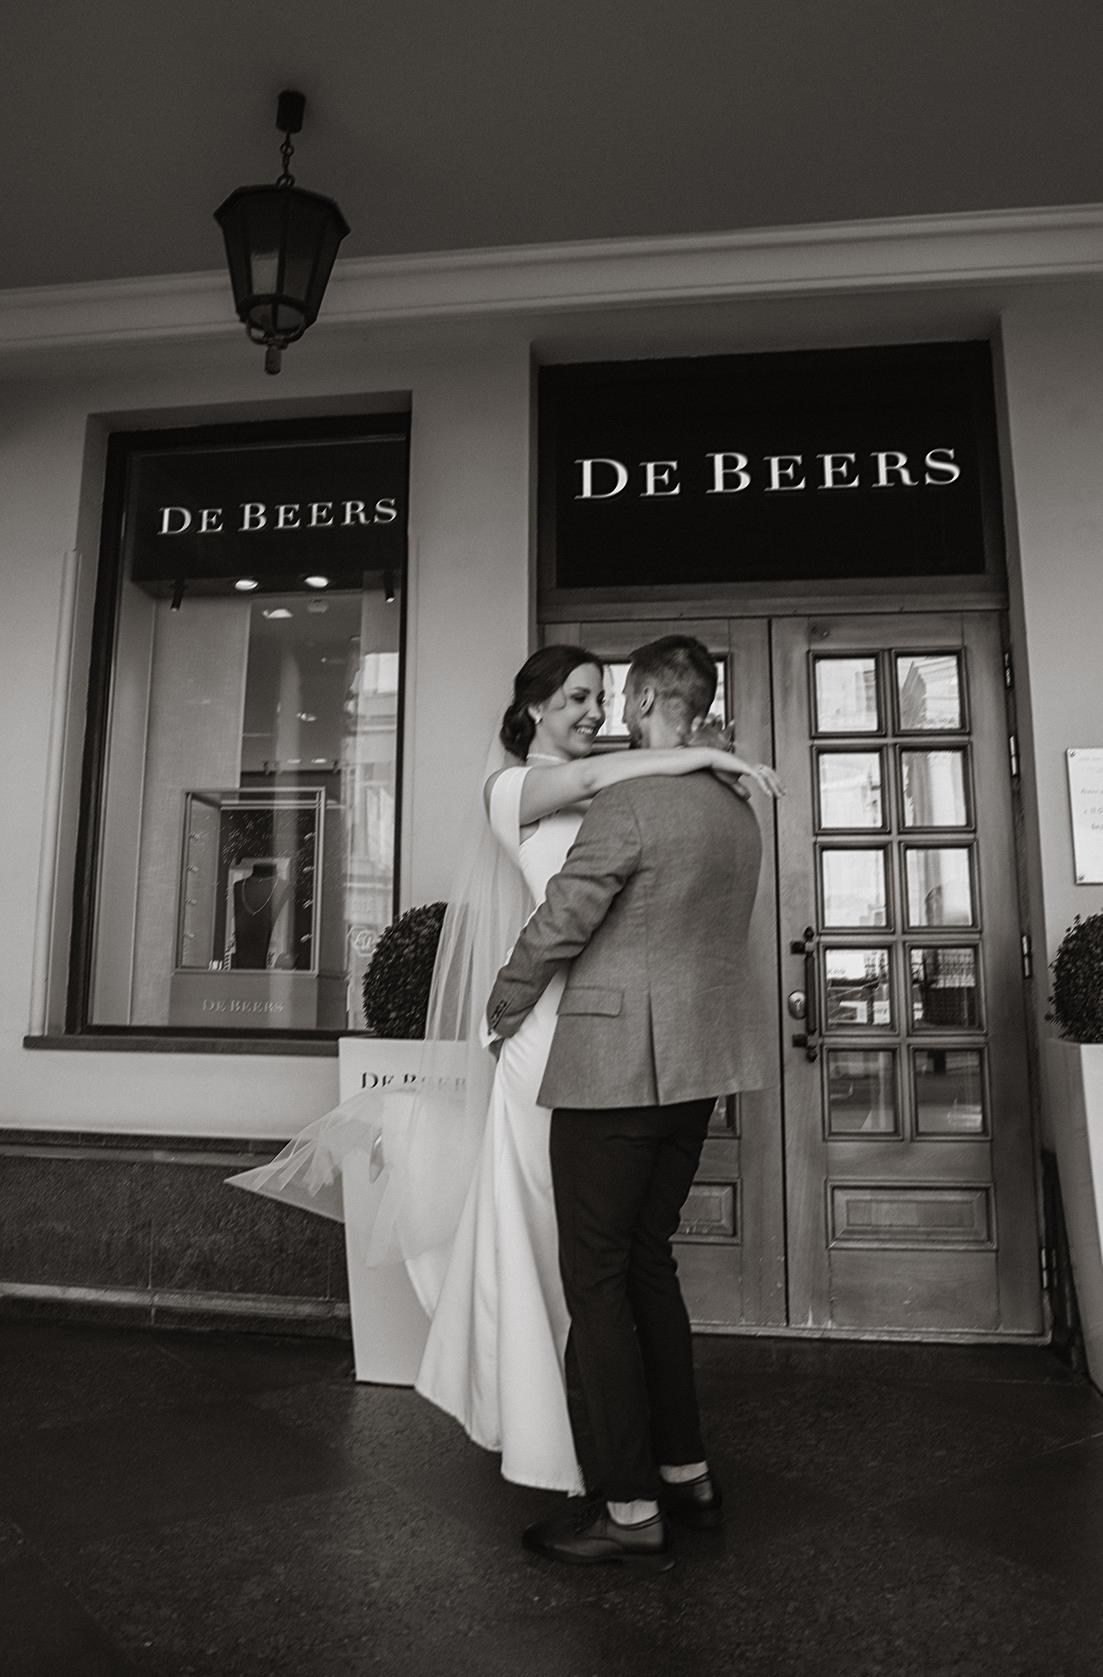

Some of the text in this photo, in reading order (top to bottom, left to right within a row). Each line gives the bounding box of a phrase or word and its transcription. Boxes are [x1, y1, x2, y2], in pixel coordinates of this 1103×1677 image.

[574, 448, 962, 500] DE BEERS
[157, 498, 398, 535] DE BEERS
[202, 999, 227, 1012] DE
